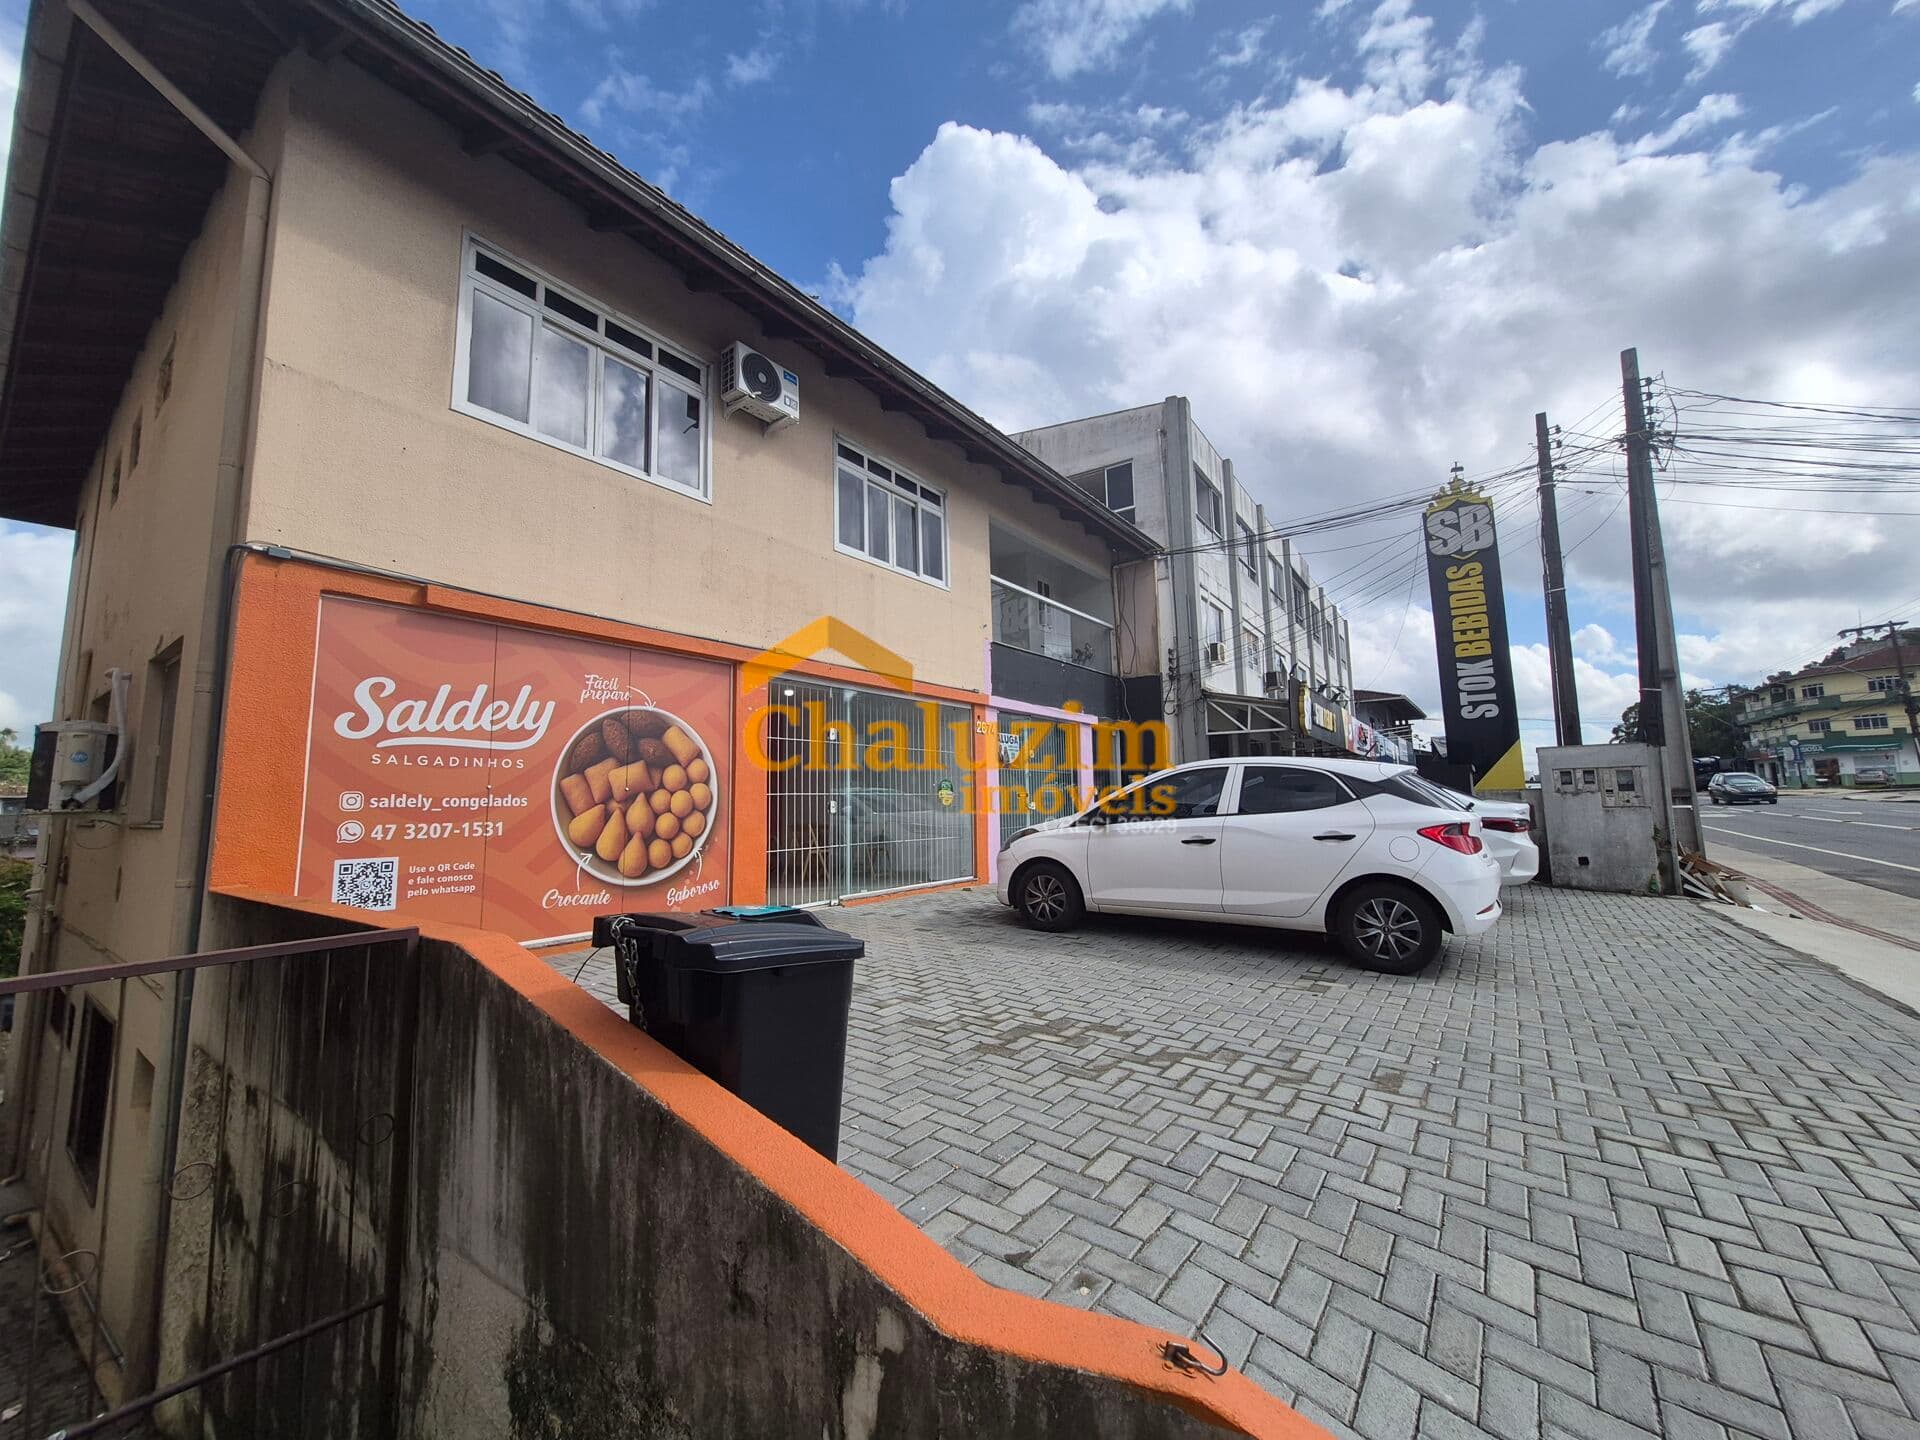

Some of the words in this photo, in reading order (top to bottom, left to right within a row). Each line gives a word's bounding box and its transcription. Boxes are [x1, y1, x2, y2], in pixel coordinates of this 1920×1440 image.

[1427, 504, 1494, 556] SB
[1446, 561, 1492, 657] BEBIDAS
[584, 674, 620, 690] Fácil
[1456, 659, 1499, 719] STOK
[580, 688, 632, 704] preparo
[333, 676, 556, 750] Saldely
[371, 753, 525, 769] SALGADINHOS
[369, 794, 528, 812] saldely_congelados
[370, 824, 397, 840] 47
[403, 821, 504, 840] 3207-1531
[409, 865, 426, 874] Use
[437, 863, 450, 872] QR
[453, 862, 475, 871] Code
[416, 875, 435, 884] fale
[437, 874, 473, 883] conosco
[407, 887, 428, 898] pelo
[431, 884, 476, 896] whatsapp
[541, 888, 612, 909] Crocante
[666, 879, 720, 906] Saboroso
